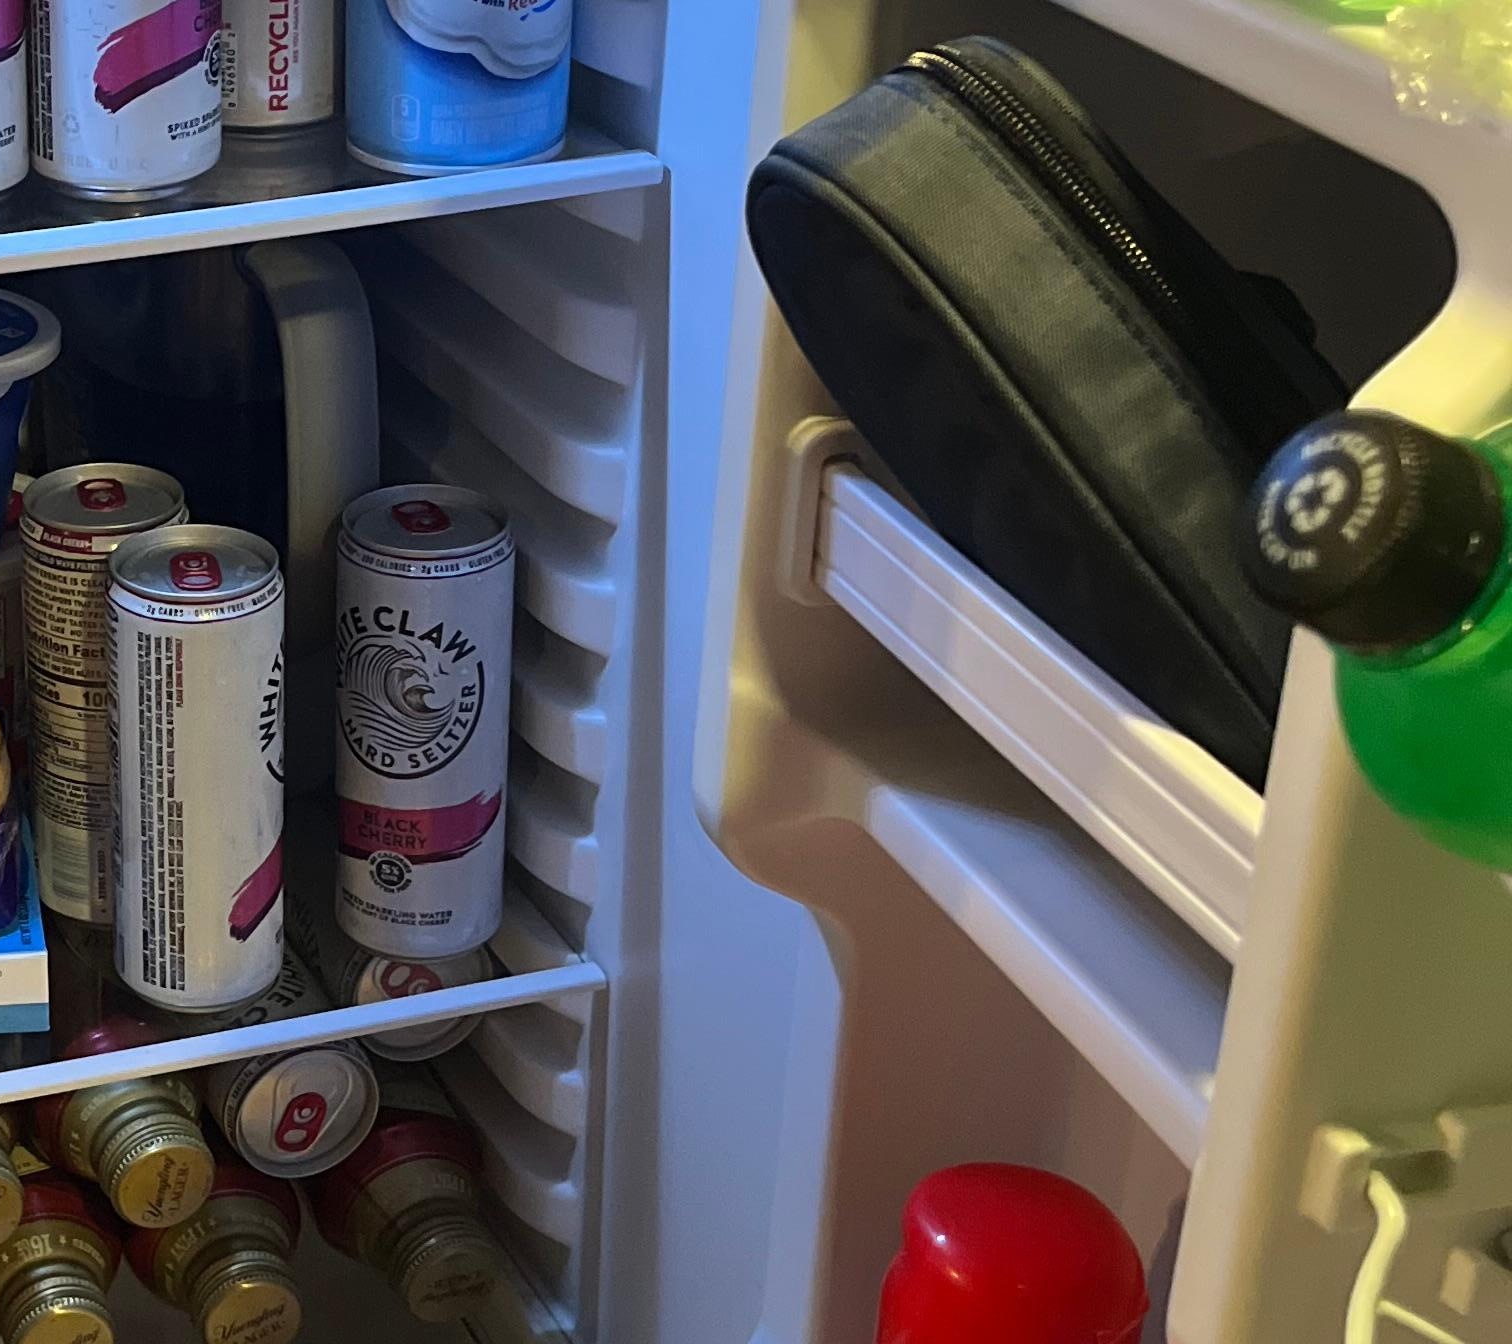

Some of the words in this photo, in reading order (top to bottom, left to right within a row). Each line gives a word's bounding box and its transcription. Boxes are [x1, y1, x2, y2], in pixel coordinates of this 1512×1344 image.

[72, 643, 106, 658] Fact
[372, 606, 477, 664] CLAW
[258, 652, 285, 753] WHIT
[342, 717, 396, 769] HARD
[407, 682, 477, 769] SELTZER
[357, 824, 427, 850] CHERRY
[362, 809, 421, 834] BLACK
[212, 1301, 286, 1344] Yuengling
